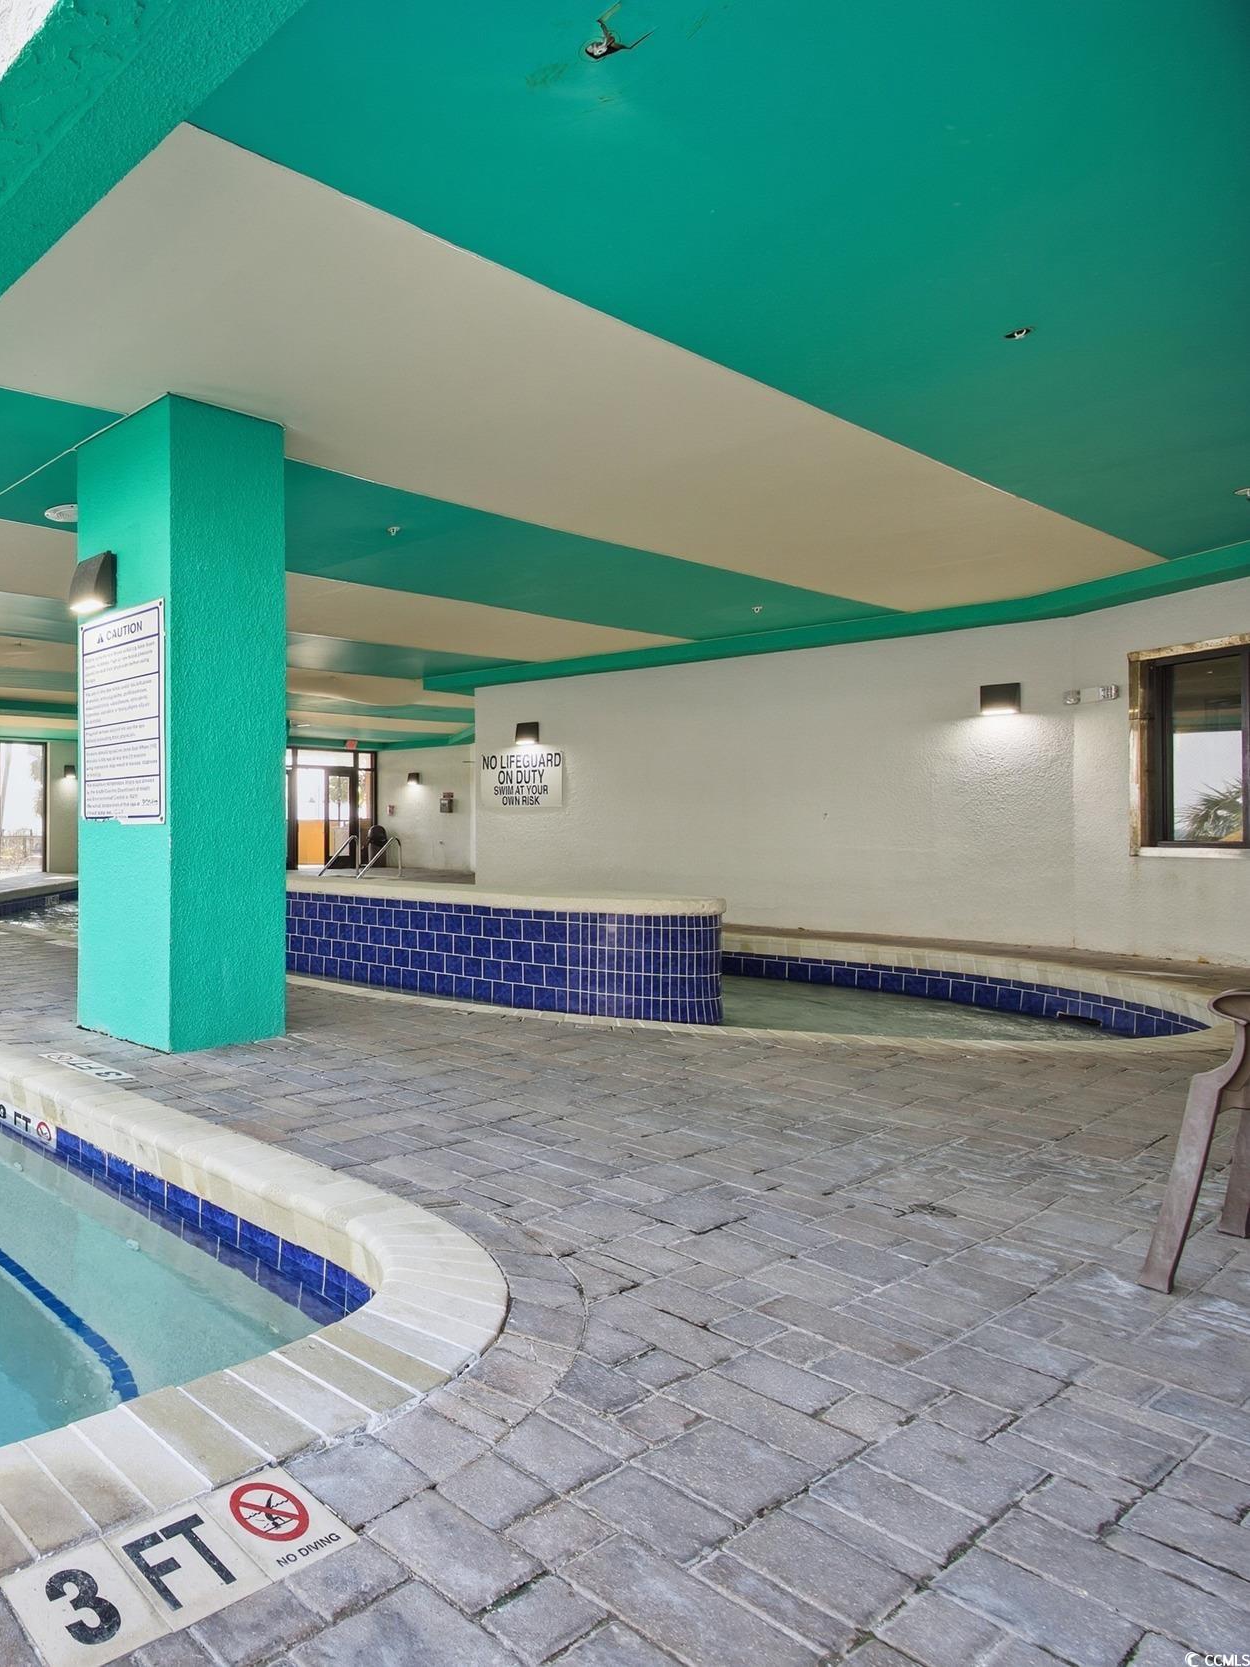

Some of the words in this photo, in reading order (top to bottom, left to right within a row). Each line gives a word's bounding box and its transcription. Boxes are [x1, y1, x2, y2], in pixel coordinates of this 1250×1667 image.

[106, 620, 143, 641] CAUTION
[482, 755, 498, 770] NO
[500, 752, 562, 769] LIFEGUARD
[497, 770, 513, 785] ON
[516, 769, 545, 784] DUTY
[493, 785, 514, 796] SWIM
[515, 785, 525, 795] AT
[526, 784, 549, 795] YOUR
[501, 795, 520, 806] OWN
[521, 795, 541, 806] RISK
[276, 1551, 298, 1569] NO
[299, 1532, 342, 1558] DIVING
[45, 1568, 122, 1646] 3
[121, 1513, 237, 1612] FT
